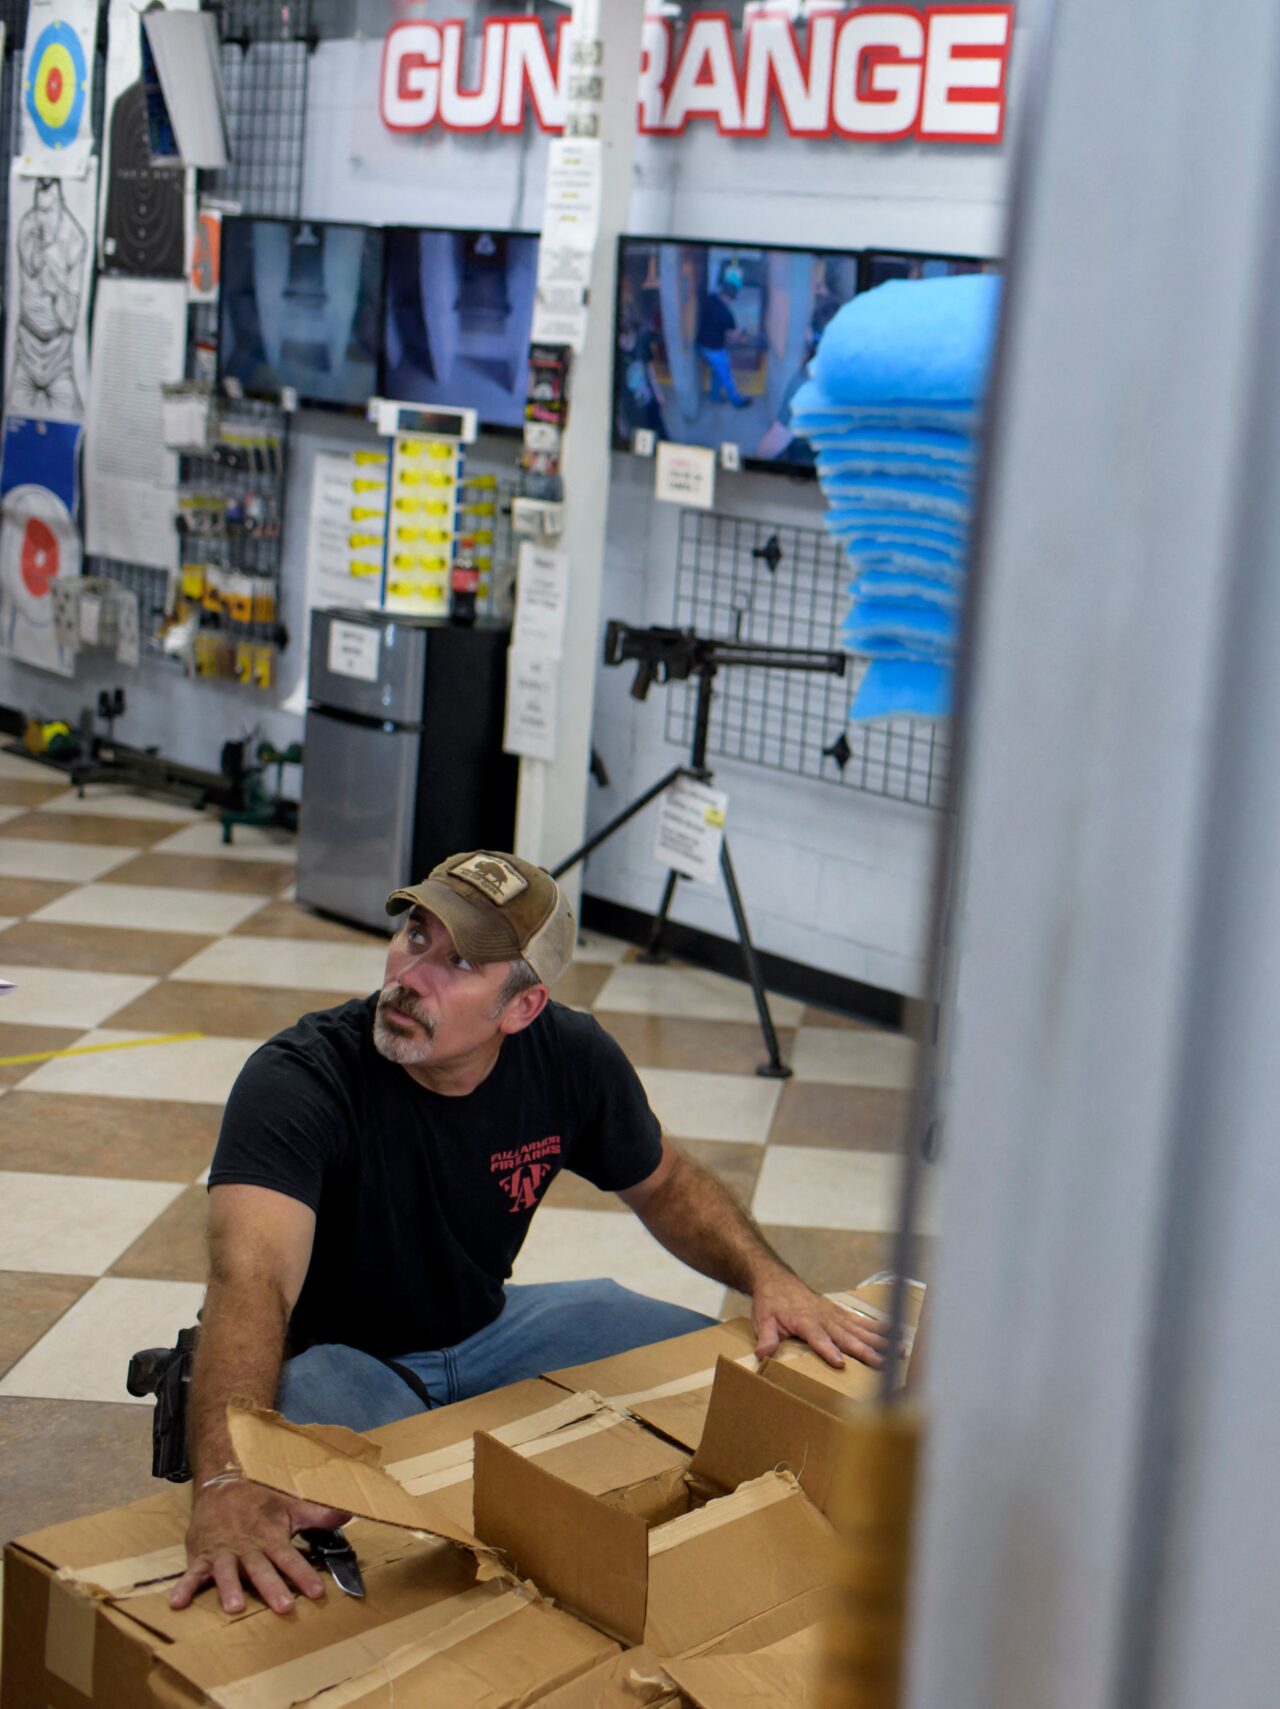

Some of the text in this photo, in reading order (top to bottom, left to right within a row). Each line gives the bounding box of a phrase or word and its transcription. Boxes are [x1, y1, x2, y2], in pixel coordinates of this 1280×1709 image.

[380, 16, 572, 134] GUN
[521, 1136, 560, 1153] ARMOR
[490, 1145, 560, 1172] FIREARMS
